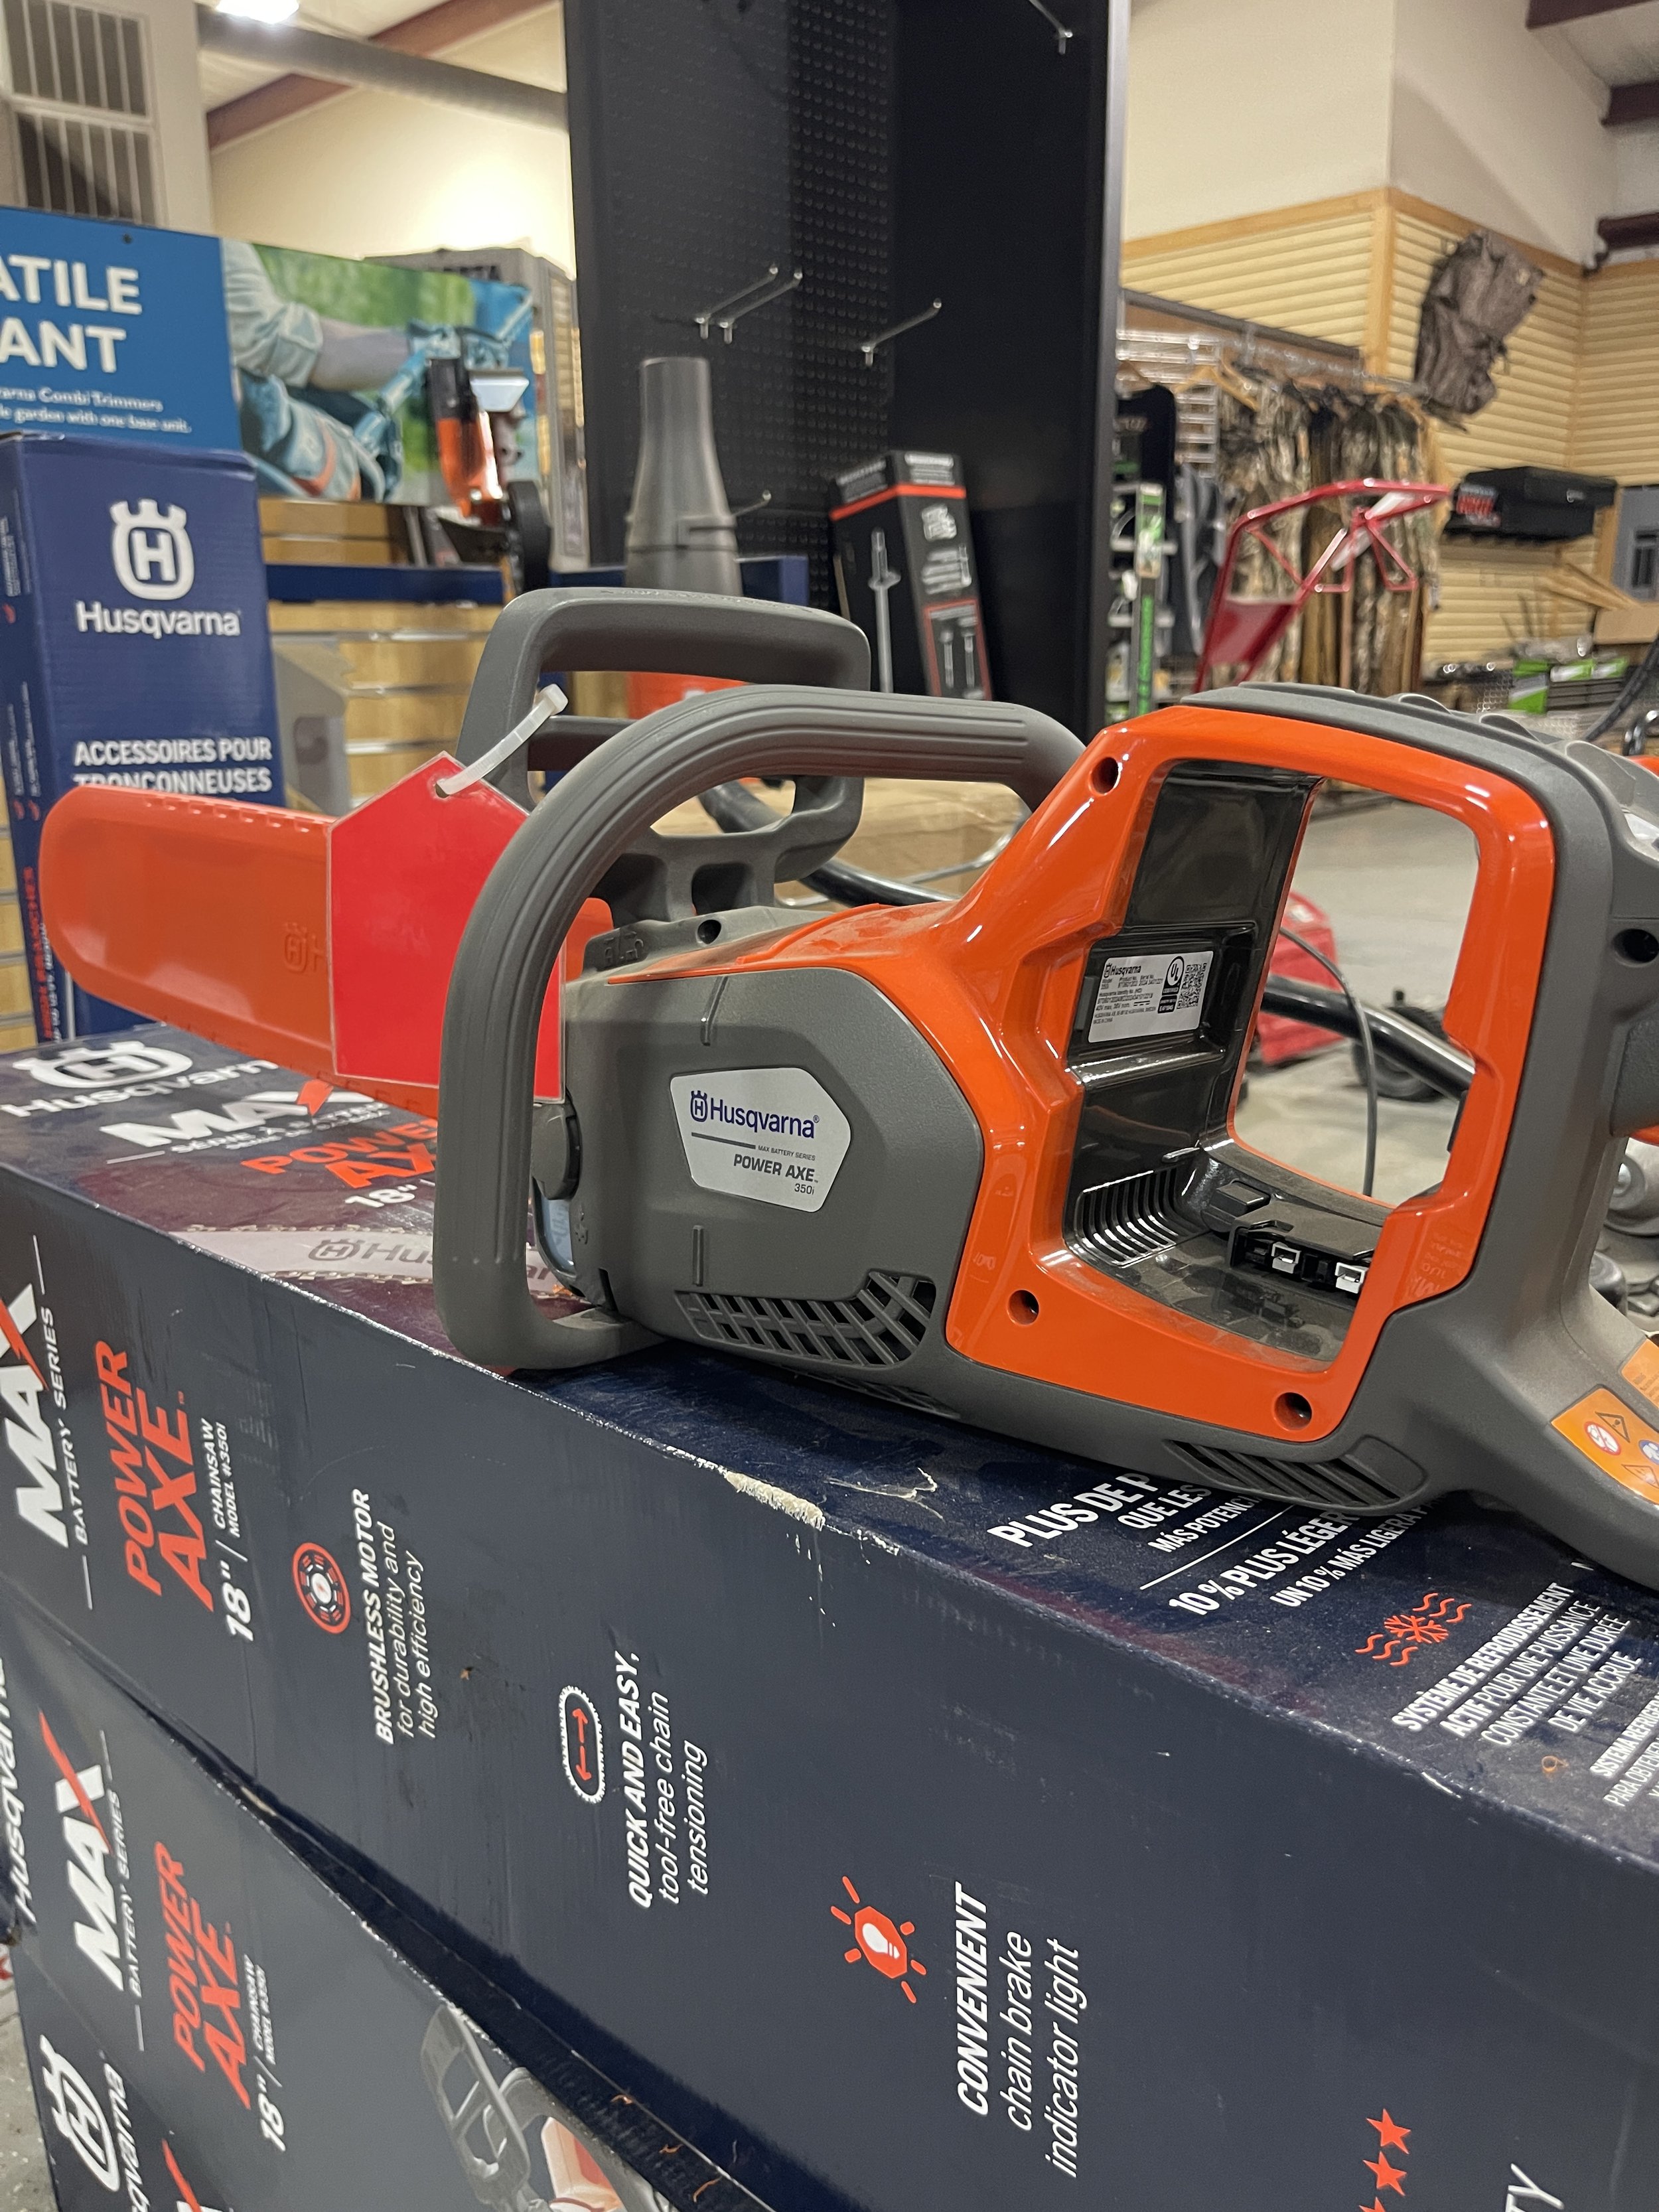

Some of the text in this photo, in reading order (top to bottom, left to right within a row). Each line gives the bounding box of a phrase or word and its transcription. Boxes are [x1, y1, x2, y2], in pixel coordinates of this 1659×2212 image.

[66, 409, 98, 425] with
[75, 600, 241, 639] Husqvarna
[74, 737, 273, 767] ACCESSOIRES POUR
[1110, 965, 1141, 978] Husqvarna
[0, 1060, 279, 1118] Husqvarn
[710, 1098, 815, 1139] Husqvarna
[770, 1147, 794, 1157] BATTERY
[795, 1152, 816, 1161] SERIES
[325, 1142, 437, 1189] AX
[733, 1153, 816, 1183] POWER AXE
[794, 1183, 815, 1195] 350i
[0, 1284, 68, 1548] MAX
[41, 1306, 88, 1545] BATTERY SERIES
[94, 1340, 162, 1596] POWER
[136, 1387, 214, 1612] AXE
[201, 1417, 254, 1641] 18" CHAINSAW
[224, 1481, 240, 1538] MODEL
[986, 1503, 1099, 1548] PLUS
[1073, 1483, 1145, 1512] DE
[1118, 1485, 1212, 1529] QUE LES
[1147, 1495, 1263, 1553] MÁS POTENCI
[1169, 1511, 1360, 1615] 10 % PLUS LÉGER
[1269, 1512, 1422, 1607] UN 10 % MÁS LIGERA
[351, 1488, 394, 1745] BRUSHLESS MOTOR
[377, 1521, 414, 1739] for durability and
[405, 1550, 439, 1739] high efficiency
[1392, 1582, 1574, 1732] SYSTÈME DE REFROIDISSEMENT
[1439, 1600, 1601, 1738] ACTIF POUR UNE PUISSANCE
[1480, 1614, 1630, 1747] CONSTANTE ET UNE DURÉE
[1548, 1651, 1644, 1733] DE VIE ACCRUE
[1589, 1692, 1659, 1777] SISTEMA REFRIGE
[614, 1651, 652, 1909] QUICK AND EASY,
[648, 1691, 680, 1904] tool-free chain
[681, 1740, 708, 1895] tensioning
[1603, 1779, 1642, 1807] PARA
[41, 1716, 124, 1991] MAX
[108, 1789, 142, 1998] BATTERY SERIES
[155, 1841, 206, 2073] POWER
[190, 1897, 251, 2110] AXE
[954, 1881, 988, 2116] CONVENIENT
[244, 1954, 285, 2152] 18" CHAINSAW
[261, 2015, 275, 2065] MODEL
[999, 1931, 1033, 2131] chain brake
[1044, 1937, 1088, 2178] indicator light
[104, 2063, 151, 2212] qvarna
